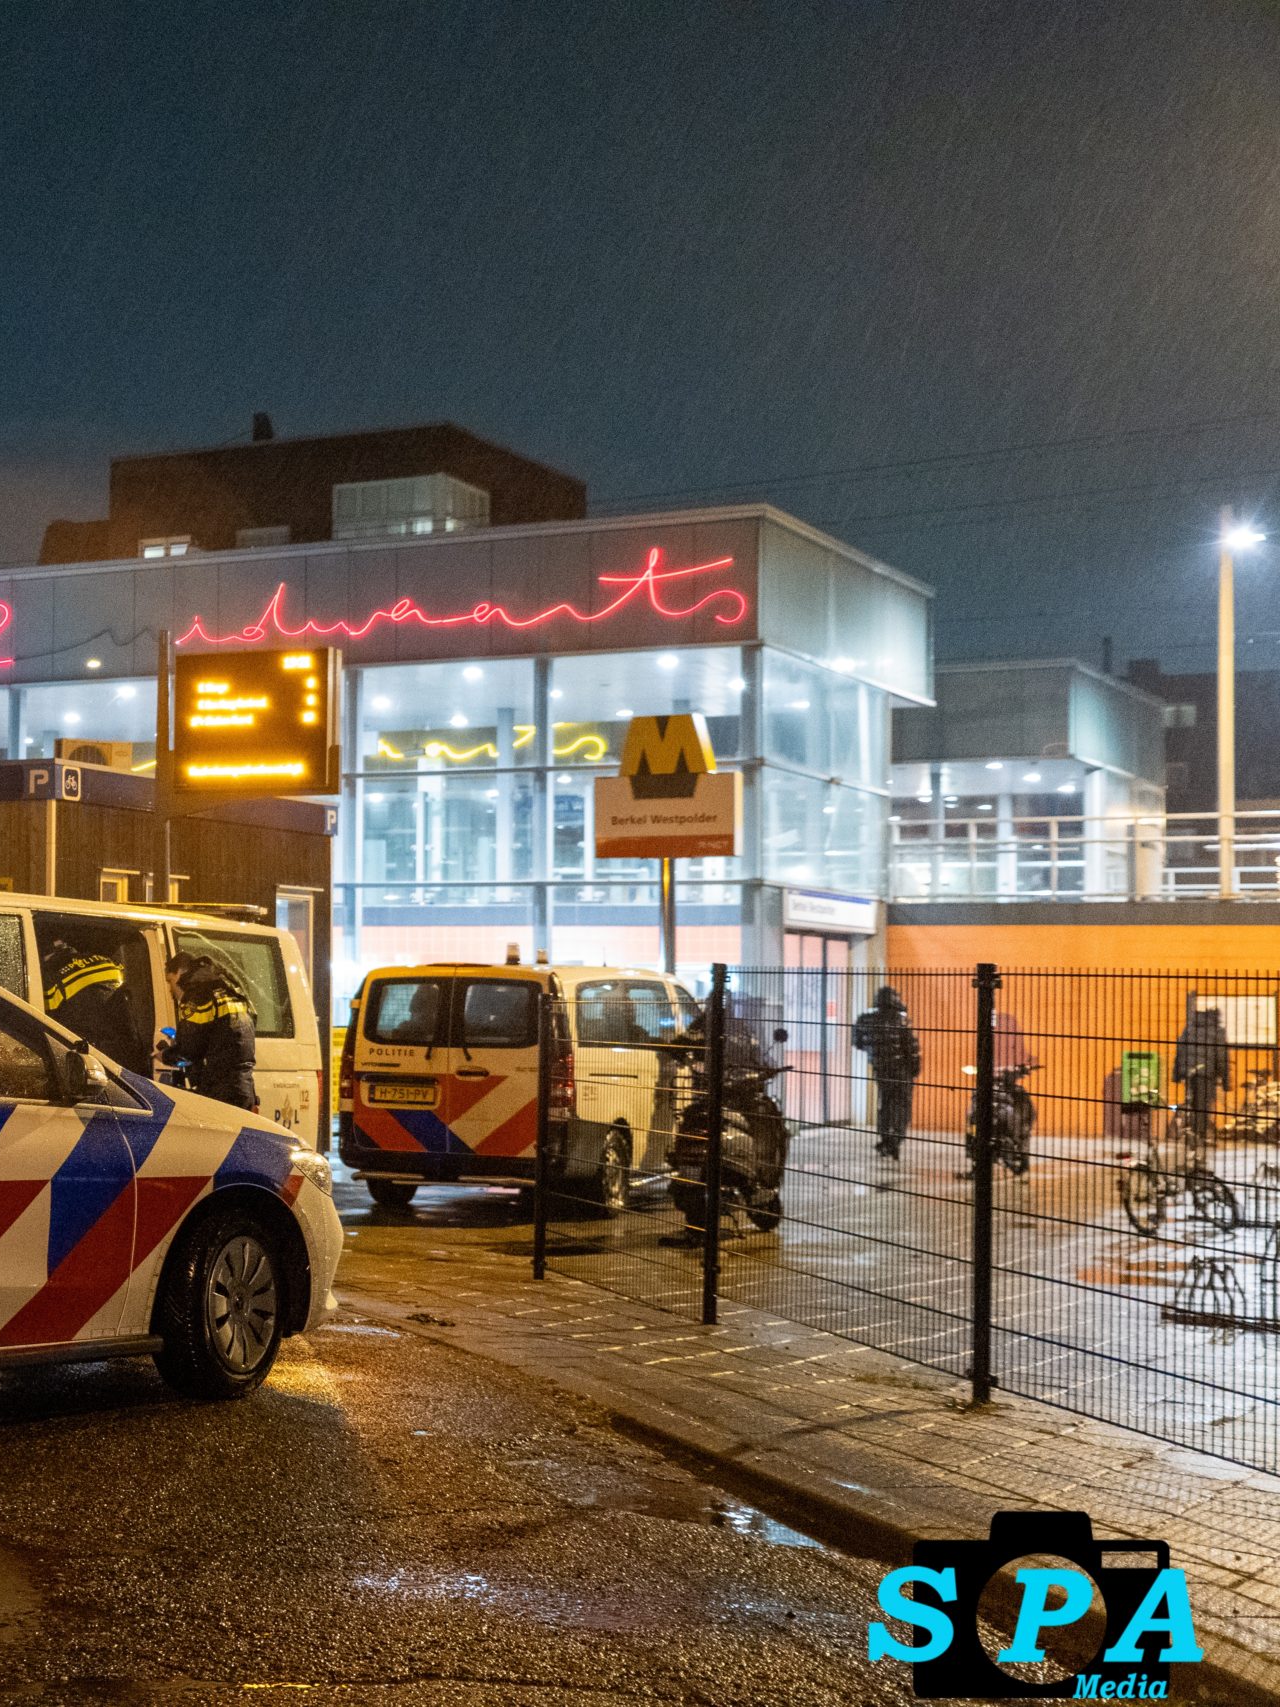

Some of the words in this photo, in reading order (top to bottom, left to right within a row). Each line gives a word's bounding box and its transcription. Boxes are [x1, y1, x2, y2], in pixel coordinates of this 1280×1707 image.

[29, 769, 49, 793] P
[327, 810, 337, 831] P
[611, 815, 647, 826] Berkel
[651, 812, 718, 825] Westpolder
[369, 1048, 415, 1057] POLITIE
